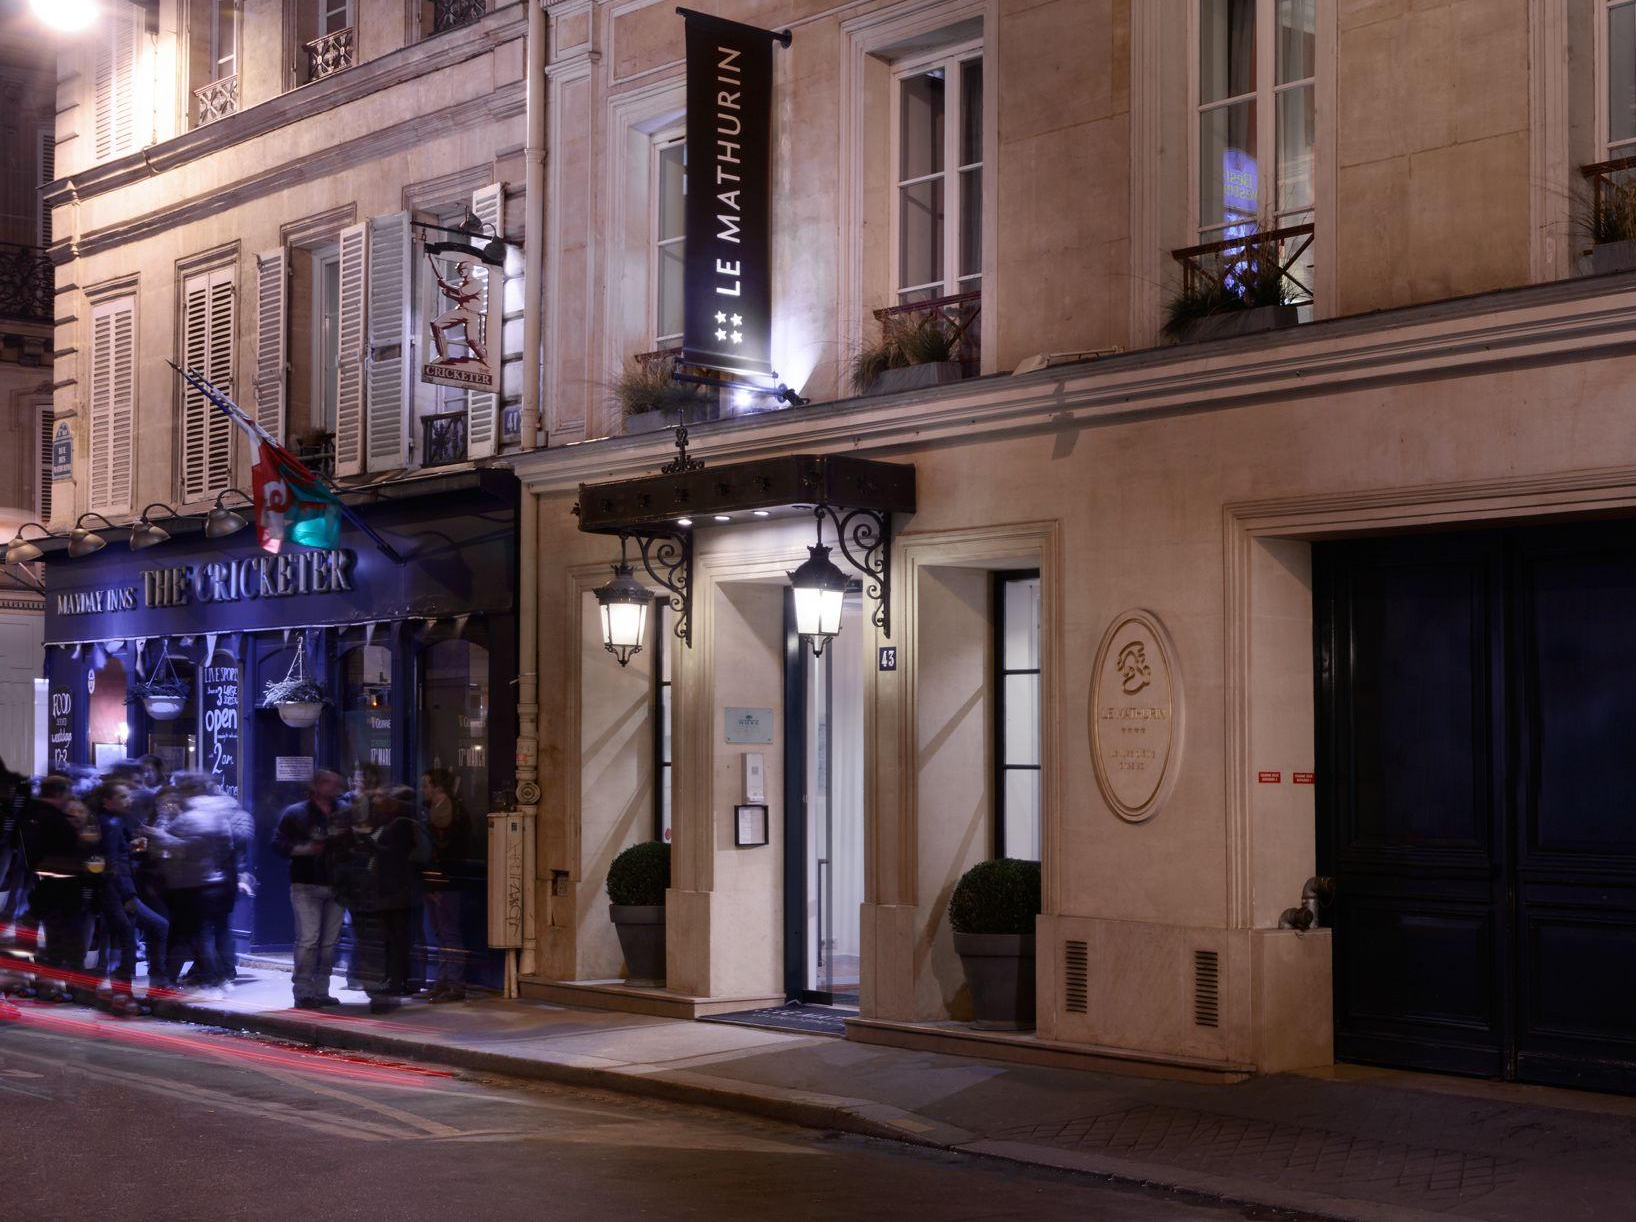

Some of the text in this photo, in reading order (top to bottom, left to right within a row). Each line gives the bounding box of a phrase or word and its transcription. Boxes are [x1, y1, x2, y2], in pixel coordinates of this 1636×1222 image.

[716, 46, 742, 296] LE MATHURIN
[425, 366, 490, 384] CRICKETER
[57, 549, 351, 615] MAYDAY INNS THE CRICKETER
[881, 650, 895, 667] 43
[205, 708, 238, 743] open
[212, 743, 222, 774] 2
